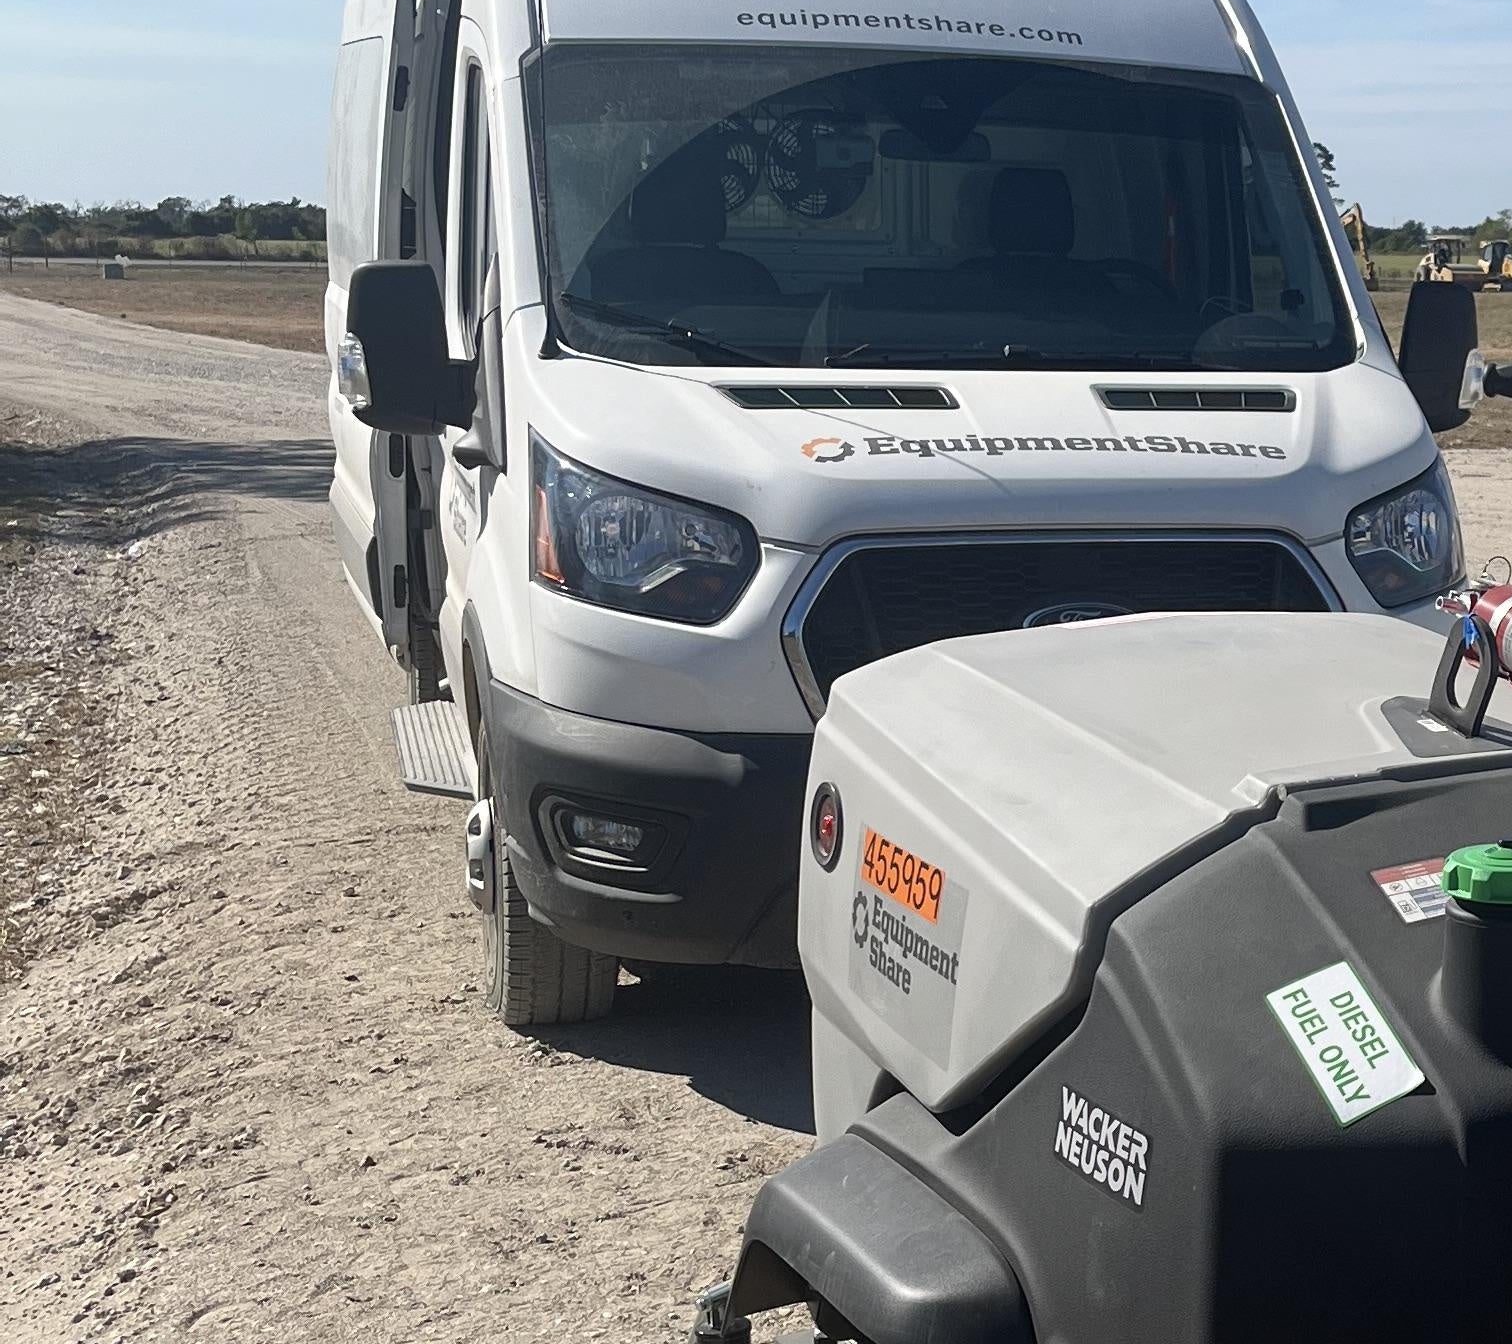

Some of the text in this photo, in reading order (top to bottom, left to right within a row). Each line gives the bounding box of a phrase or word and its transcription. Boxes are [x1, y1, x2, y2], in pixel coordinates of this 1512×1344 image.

[736, 9, 1084, 46] equipmentshare.com
[863, 433, 1287, 460] EquipmentShare
[864, 832, 943, 920] 455959
[869, 934, 912, 995] Share
[871, 894, 960, 986] Equipment
[1282, 987, 1371, 1104] FUEL ONLY
[1329, 990, 1390, 1070] DIESEL
[1054, 1120, 1146, 1206] NEUSON
[1062, 1085, 1149, 1171] WACKER
